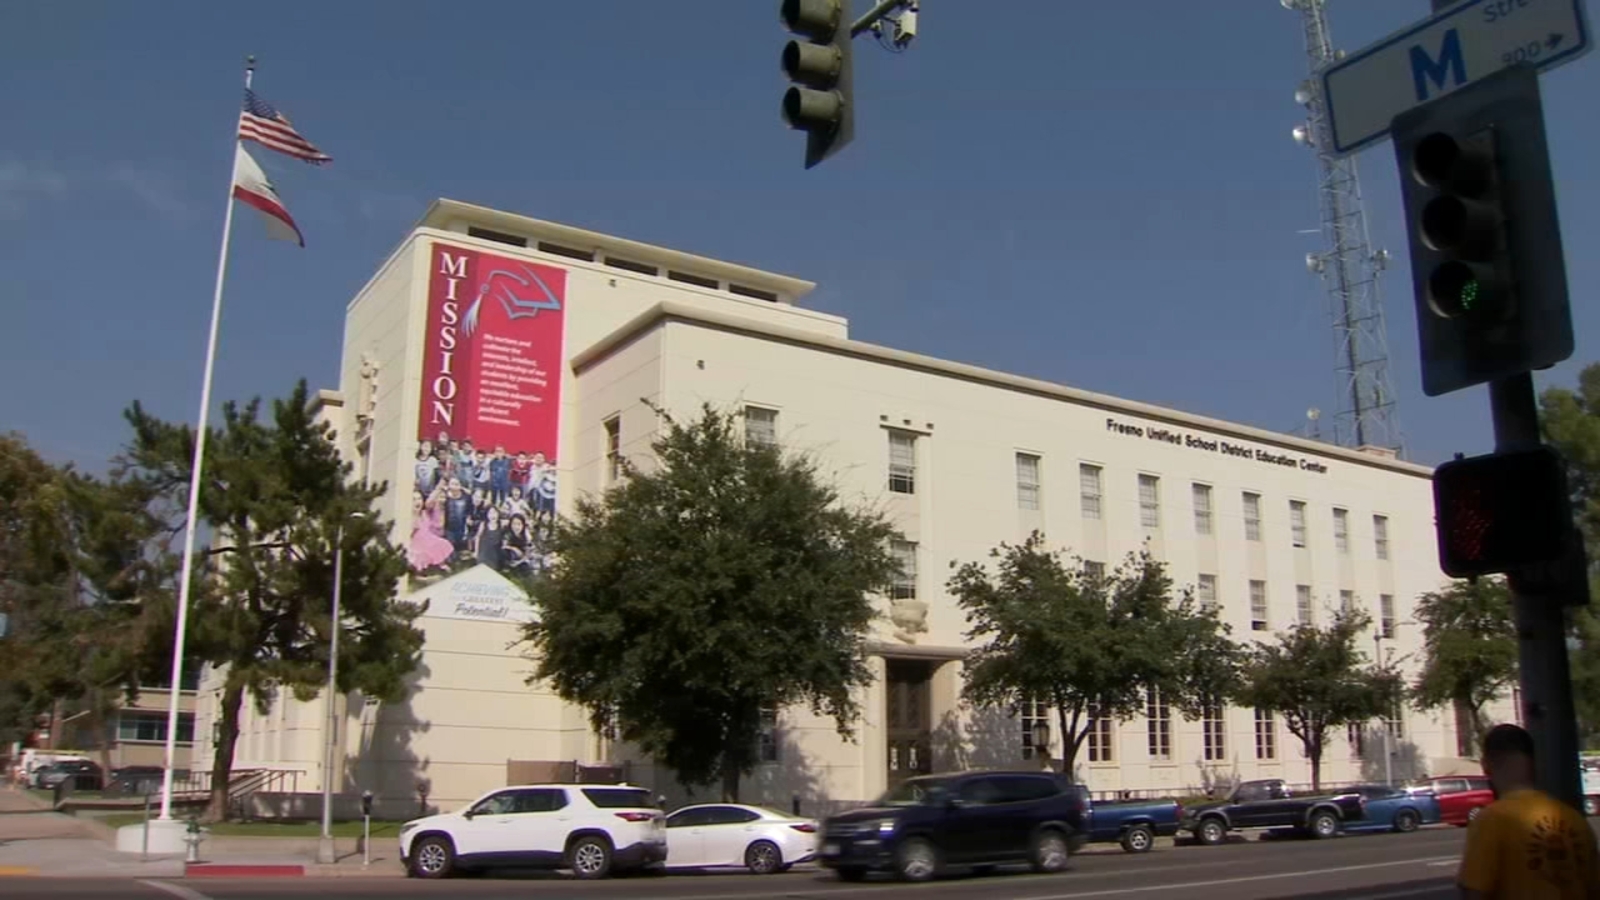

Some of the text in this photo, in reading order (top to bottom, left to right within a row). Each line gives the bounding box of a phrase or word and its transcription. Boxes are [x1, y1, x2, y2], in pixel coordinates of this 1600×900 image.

[1409, 28, 1467, 101] M
[431, 252, 468, 425] MISSION
[1106, 418, 1327, 474] Fresno Unified School District Education Center
